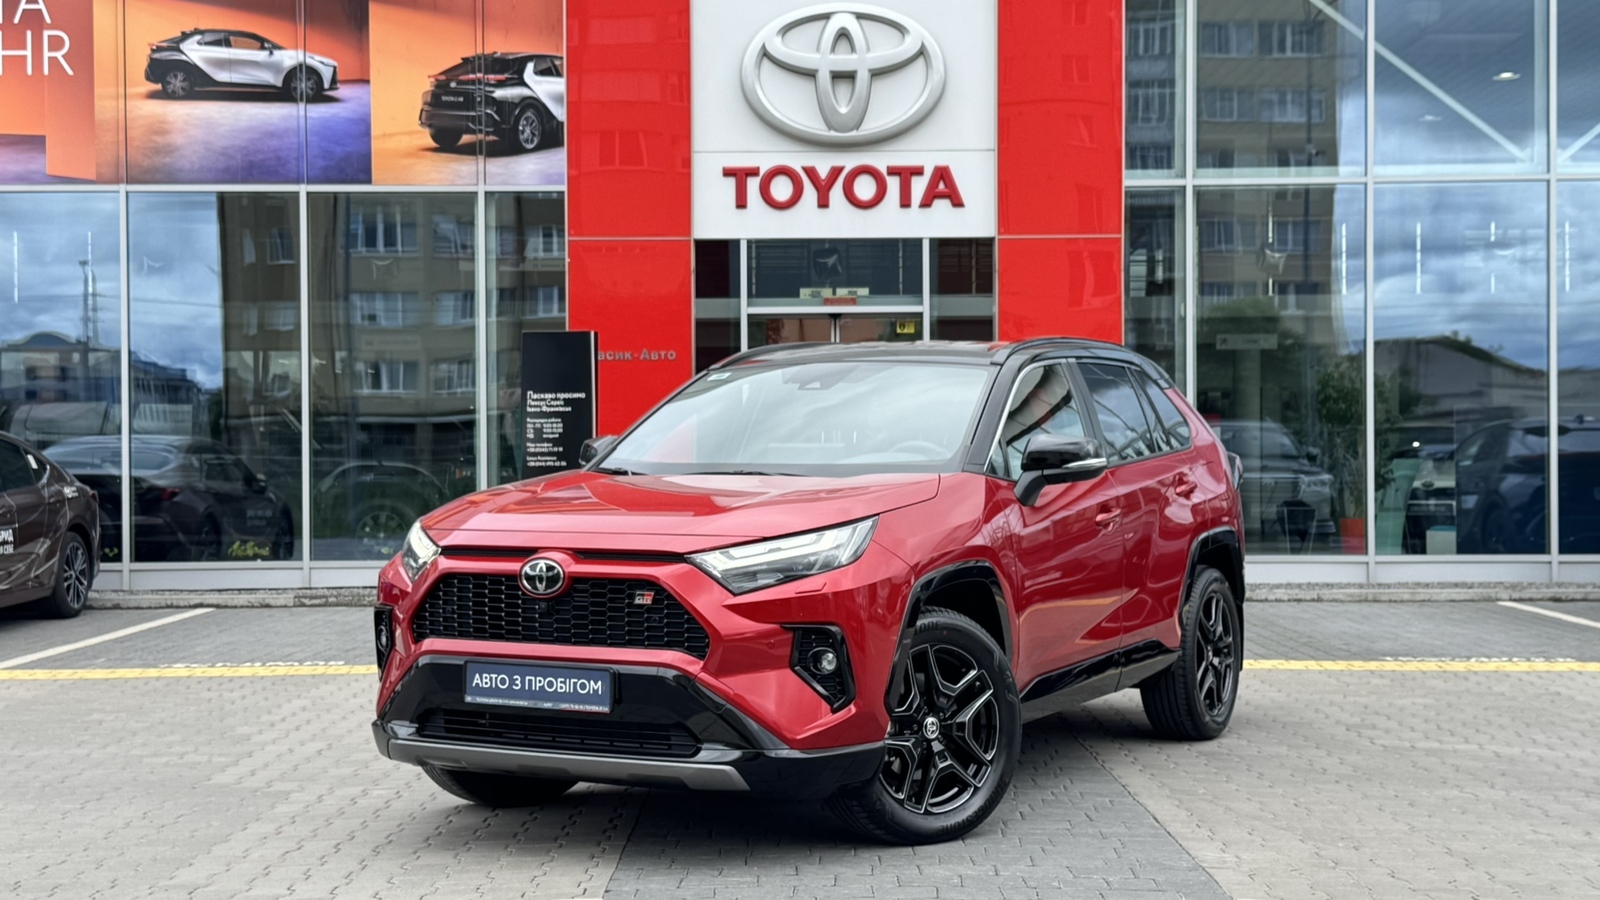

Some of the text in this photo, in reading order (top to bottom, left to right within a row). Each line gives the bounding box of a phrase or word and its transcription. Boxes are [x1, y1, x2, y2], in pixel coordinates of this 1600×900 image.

[722, 164, 966, 211] TOYOTA
[472, 673, 510, 689] АВТО
[525, 676, 602, 695] ПРОБІГОМ
